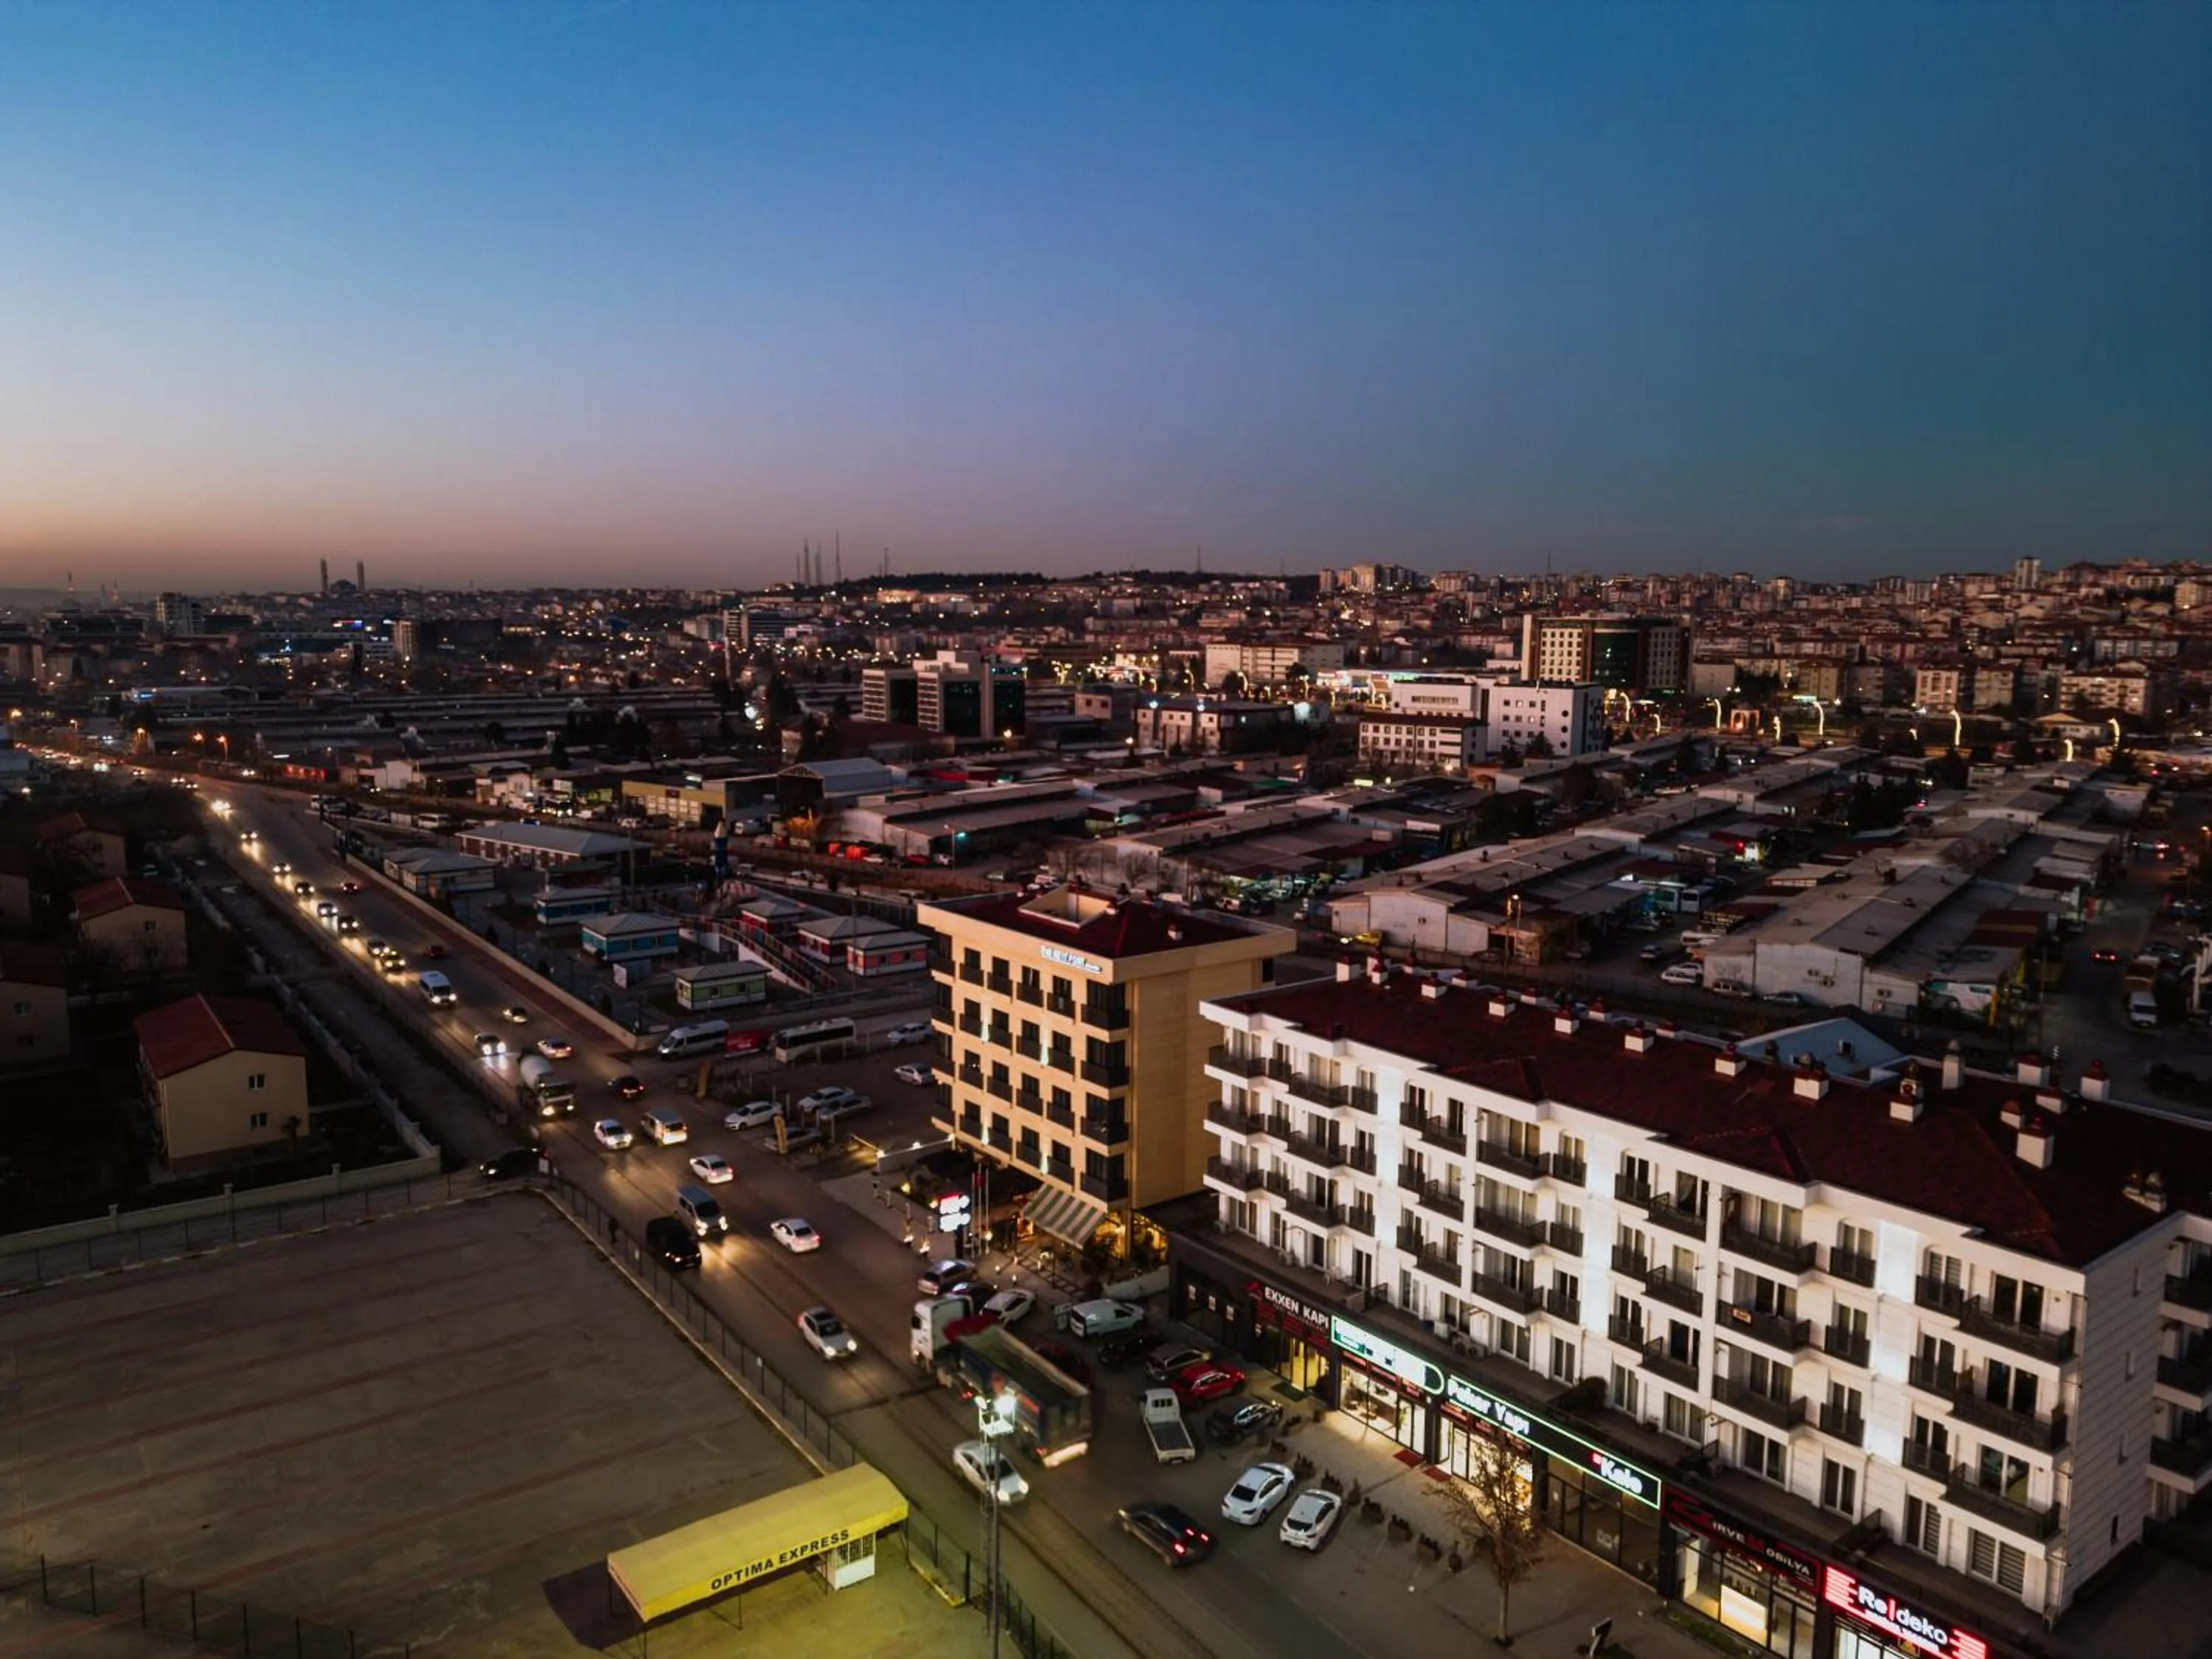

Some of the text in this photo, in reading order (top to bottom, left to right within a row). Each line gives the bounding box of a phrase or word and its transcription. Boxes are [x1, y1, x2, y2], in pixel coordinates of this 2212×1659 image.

[1265, 1287, 1299, 1313] EXXEN
[1303, 1305, 1329, 1329] KAPI
[711, 1529, 850, 1591] OPTIMA EXPRESS
